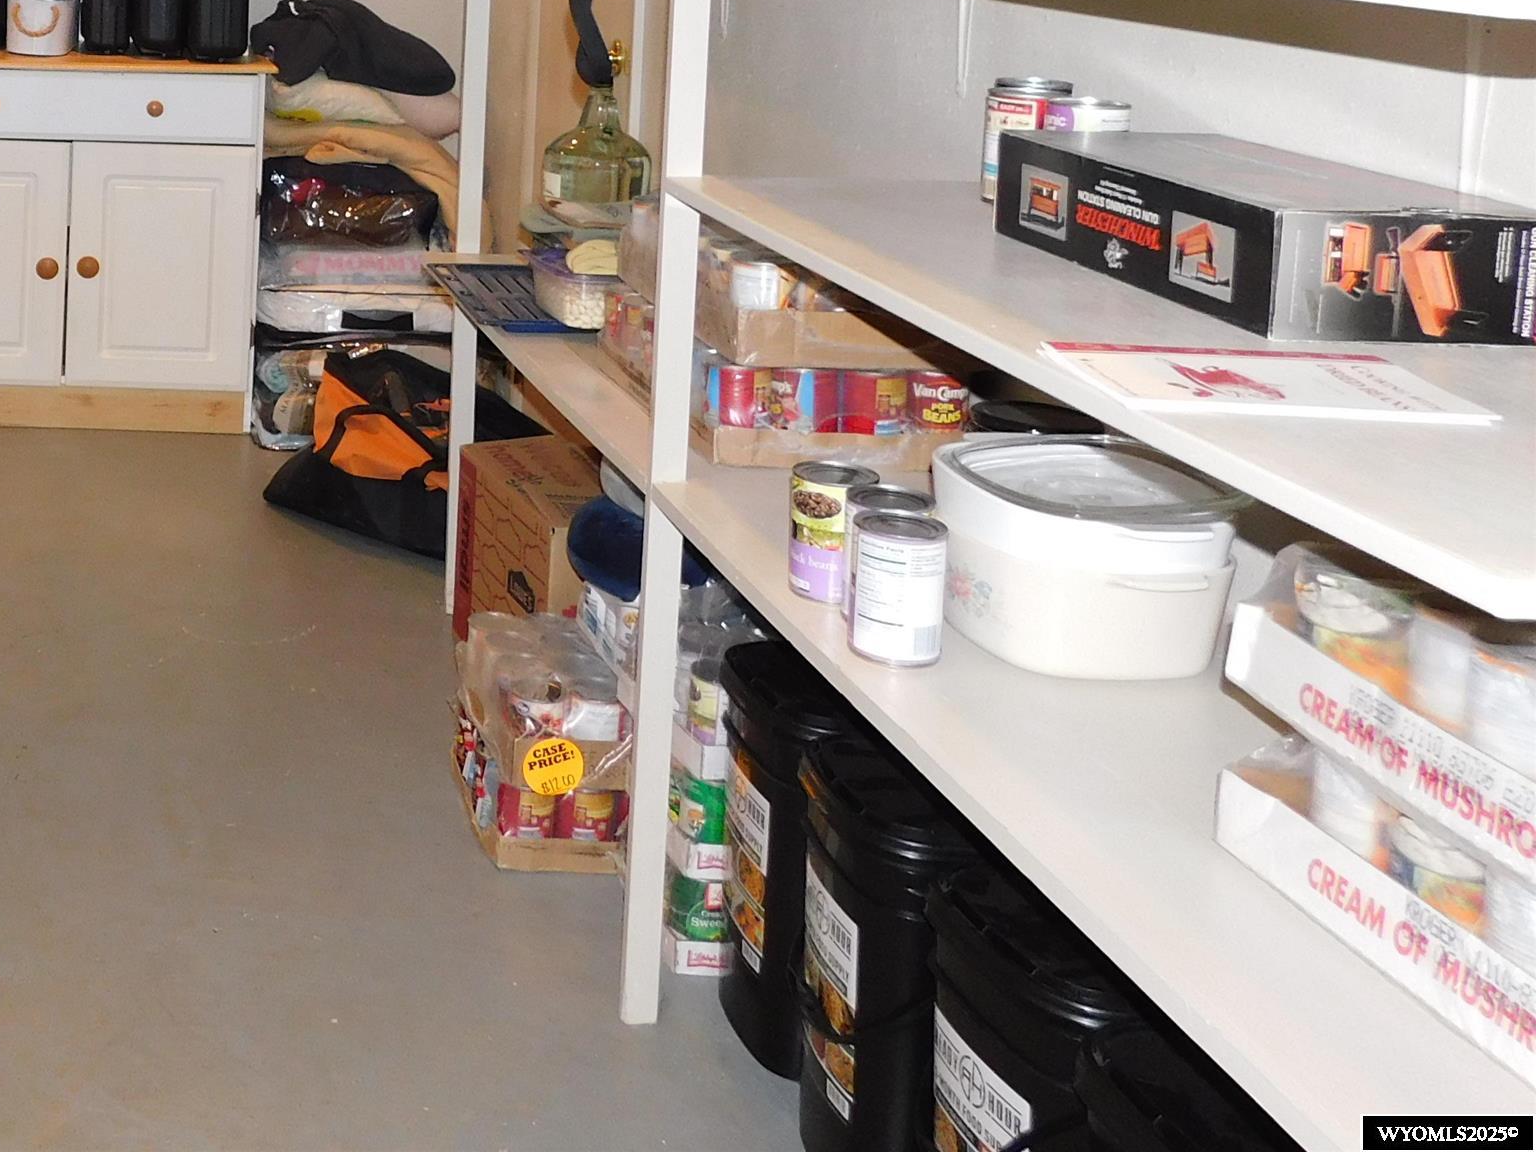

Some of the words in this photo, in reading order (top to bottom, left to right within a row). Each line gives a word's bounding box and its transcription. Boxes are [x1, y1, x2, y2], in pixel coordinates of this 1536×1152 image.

[1105, 197, 1142, 220] CLEANING
[1075, 203, 1162, 251] WINCHESTER
[1520, 298, 1534, 338] STATION
[913, 382, 937, 398] Van
[922, 408, 961, 424] BEANS
[1299, 682, 1377, 753] CREAM
[1380, 736, 1409, 776] OF
[527, 750, 576, 771] PRICE!
[532, 742, 567, 759] CASE
[1307, 858, 1387, 938] CREAM
[1393, 920, 1429, 965] OF
[962, 1103, 982, 1136] FOOD
[987, 1090, 1021, 1136] HOUR
